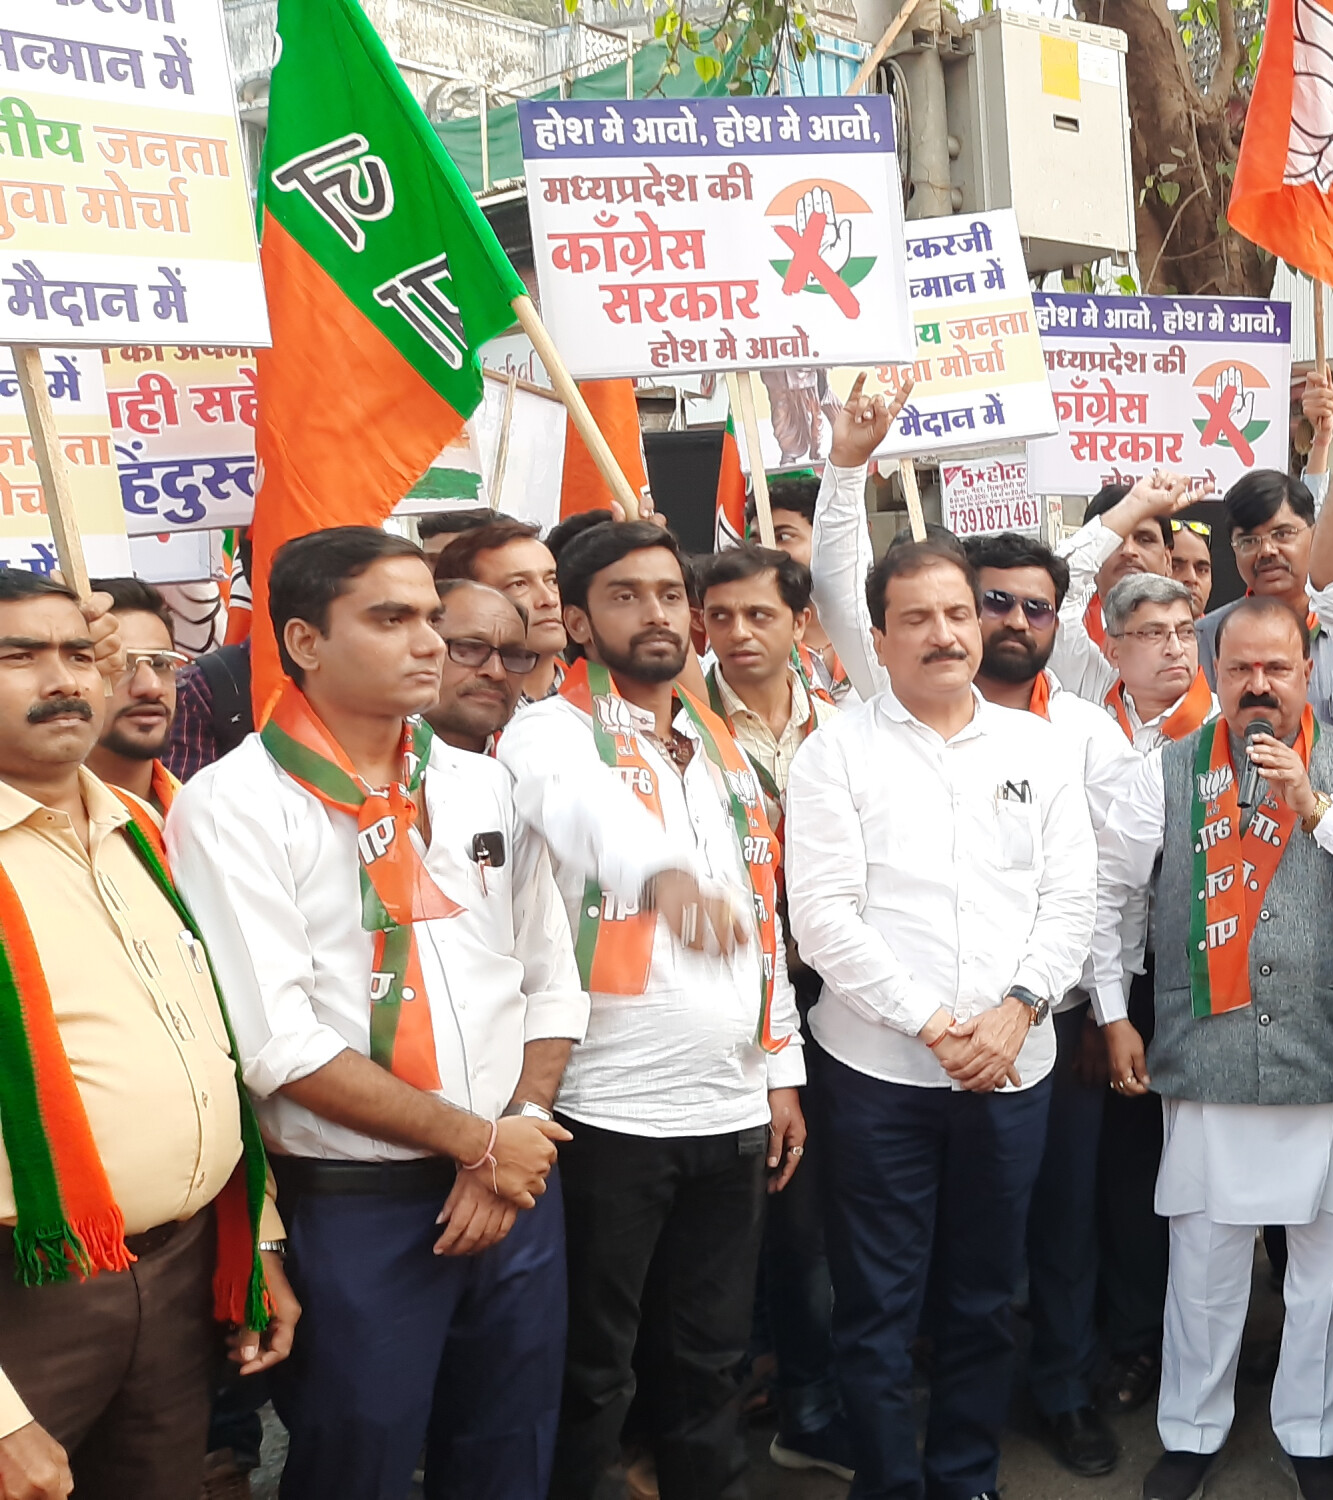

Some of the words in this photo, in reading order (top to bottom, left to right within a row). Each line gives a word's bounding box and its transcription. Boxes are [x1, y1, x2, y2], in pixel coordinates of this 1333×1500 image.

[153, 34, 195, 95] में
[534, 107, 594, 151] होश
[633, 106, 708, 147] आवो,
[713, 106, 773, 147] होश
[808, 103, 881, 144] आवो,
[93, 126, 229, 177] जनता
[76, 170, 191, 233] मोर्चा
[540, 163, 698, 207] मध्यप्रदेश
[705, 162, 754, 202] की
[2, 260, 139, 327] मैदान
[149, 266, 188, 324] में
[981, 257, 1006, 290] में
[599, 280, 760, 324] सरकार
[1035, 298, 1078, 330] होश
[1163, 302, 1202, 335] होश
[648, 330, 708, 368] होश
[746, 325, 820, 360] आवो.
[946, 311, 1030, 341] जनता
[44, 354, 81, 402] में
[937, 339, 1006, 378] मोर्चा
[1153, 345, 1186, 375] की
[895, 403, 976, 438] मैदान
[980, 393, 1006, 425] में
[1069, 431, 1184, 463] सरकार
[949, 500, 1039, 535] 7391871461
